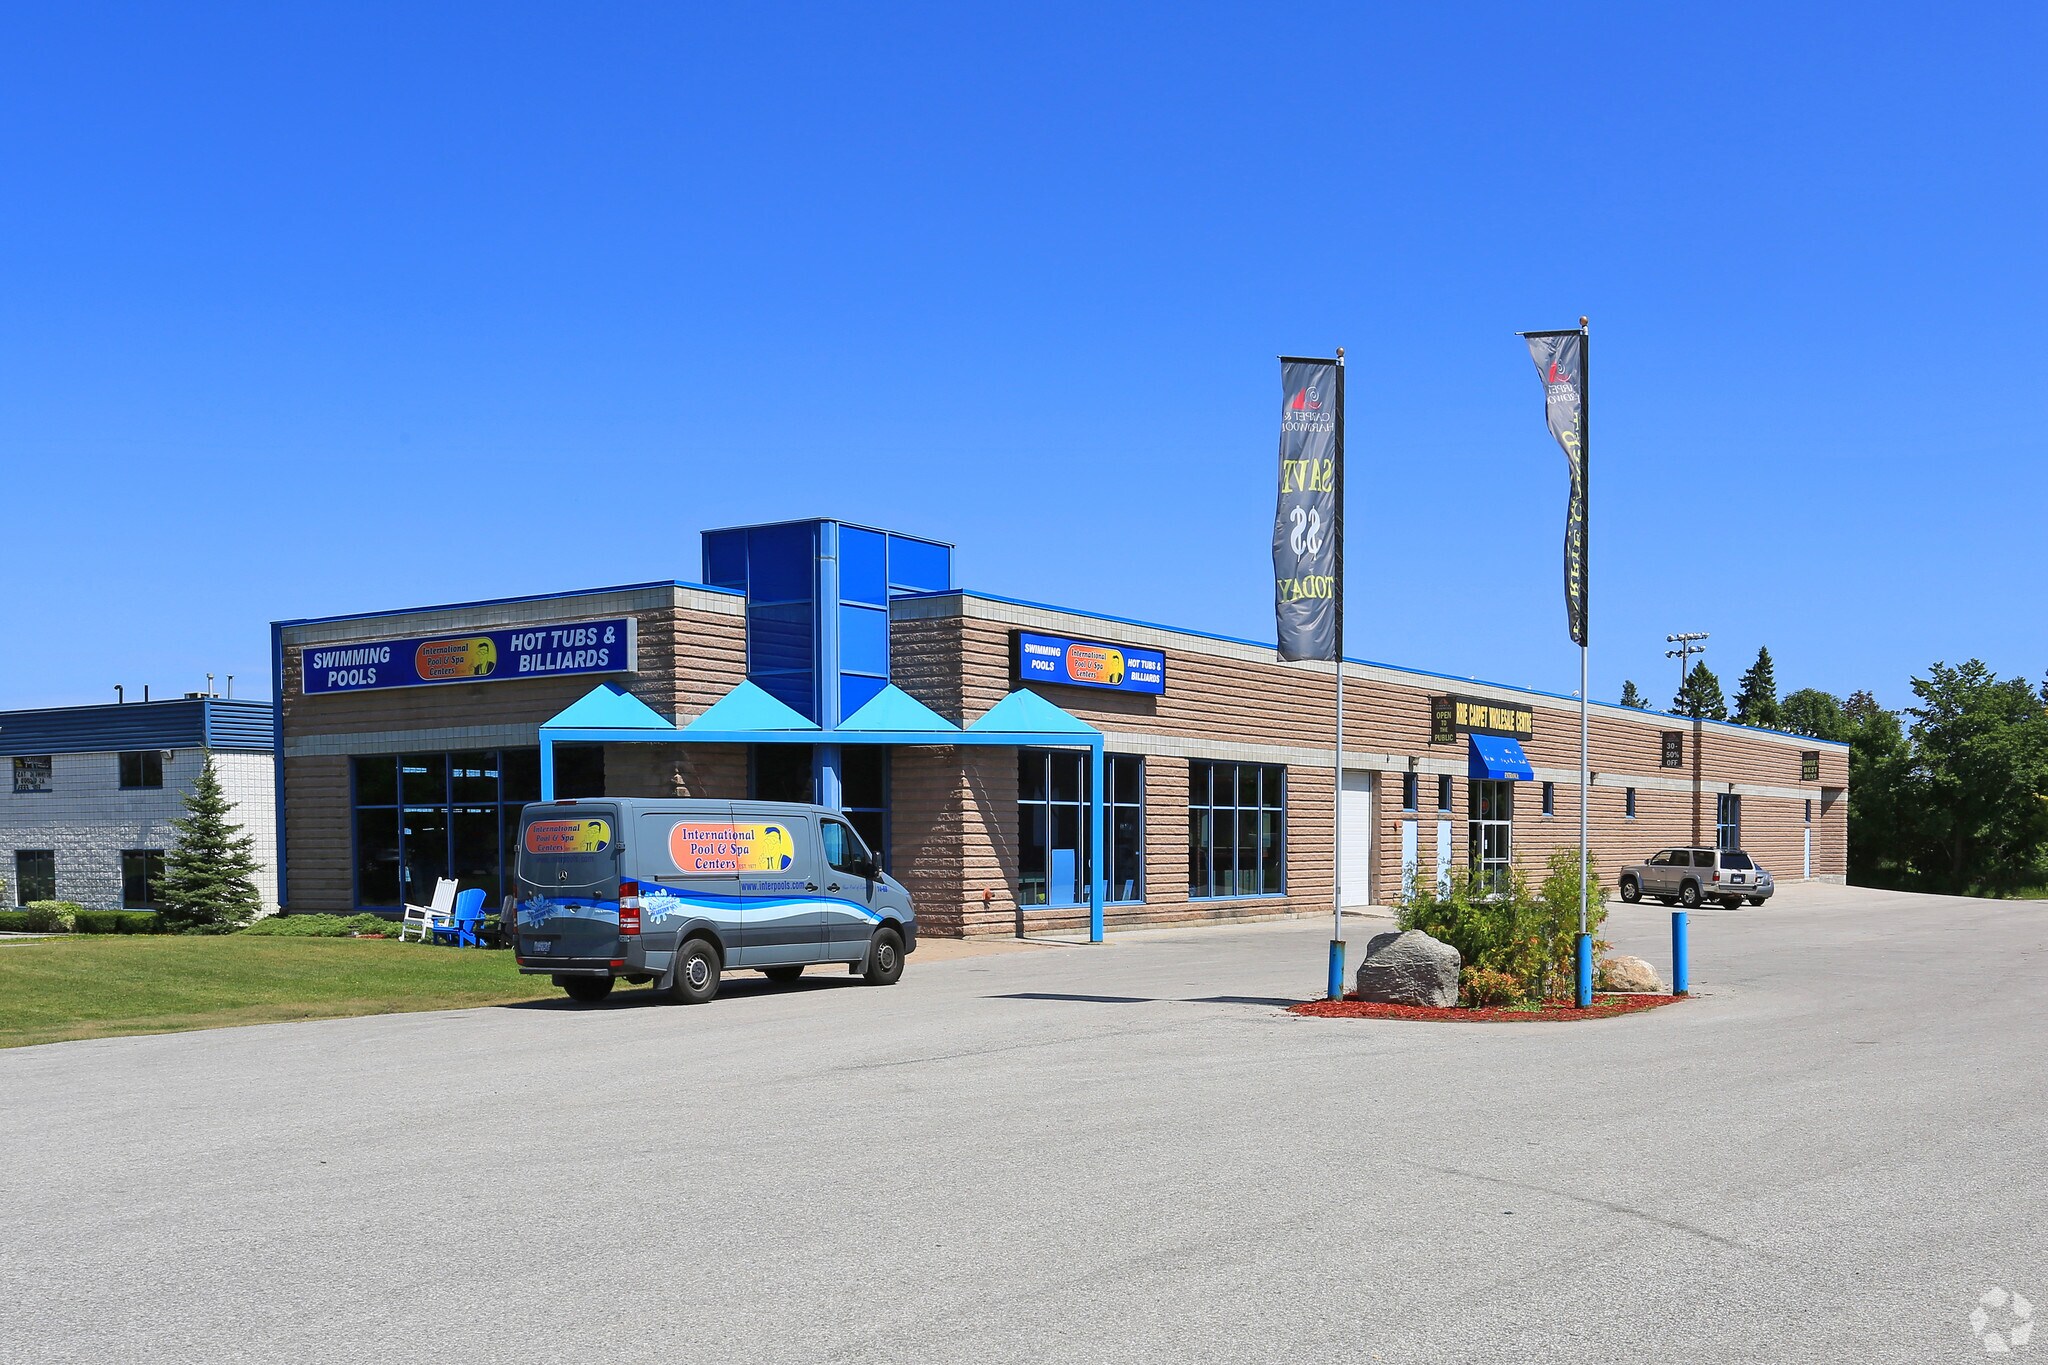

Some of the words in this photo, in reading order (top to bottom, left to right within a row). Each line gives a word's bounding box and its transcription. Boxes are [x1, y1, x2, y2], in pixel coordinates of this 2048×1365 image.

[510, 632, 546, 652] HOT
[551, 627, 598, 648] TUBS
[603, 625, 616, 644] &
[422, 643, 469, 656] International
[1024, 643, 1061, 657] SWIMMING
[1071, 649, 1107, 661] International
[313, 646, 391, 669] SWIMMING
[427, 657, 442, 666] Pool
[451, 655, 465, 665] Spa
[518, 648, 610, 672] BILLIARDS
[1031, 659, 1055, 671] POOLS
[1127, 658, 1141, 669] HOT
[1141, 660, 1156, 671] TUBS
[1156, 662, 1162, 671] &
[328, 667, 377, 688] POOLS
[429, 667, 455, 676] Centers
[1130, 671, 1161, 684] BILLIARDS
[1436, 711, 1452, 720] OPEN
[1469, 704, 1488, 728] CARPET
[1516, 710, 1532, 733] CENTRE
[1434, 734, 1454, 742] PUBLIC
[1666, 751, 1680, 759] 50%
[533, 824, 580, 833] International
[682, 828, 755, 841] International
[536, 834, 551, 842] Pool
[560, 833, 575, 843] Spa
[537, 844, 563, 852] Centers
[690, 843, 714, 855] Pool
[717, 843, 727, 855] &
[730, 843, 750, 857] Spa
[695, 857, 736, 869] Centers
[741, 880, 805, 892] www.interpools.com
